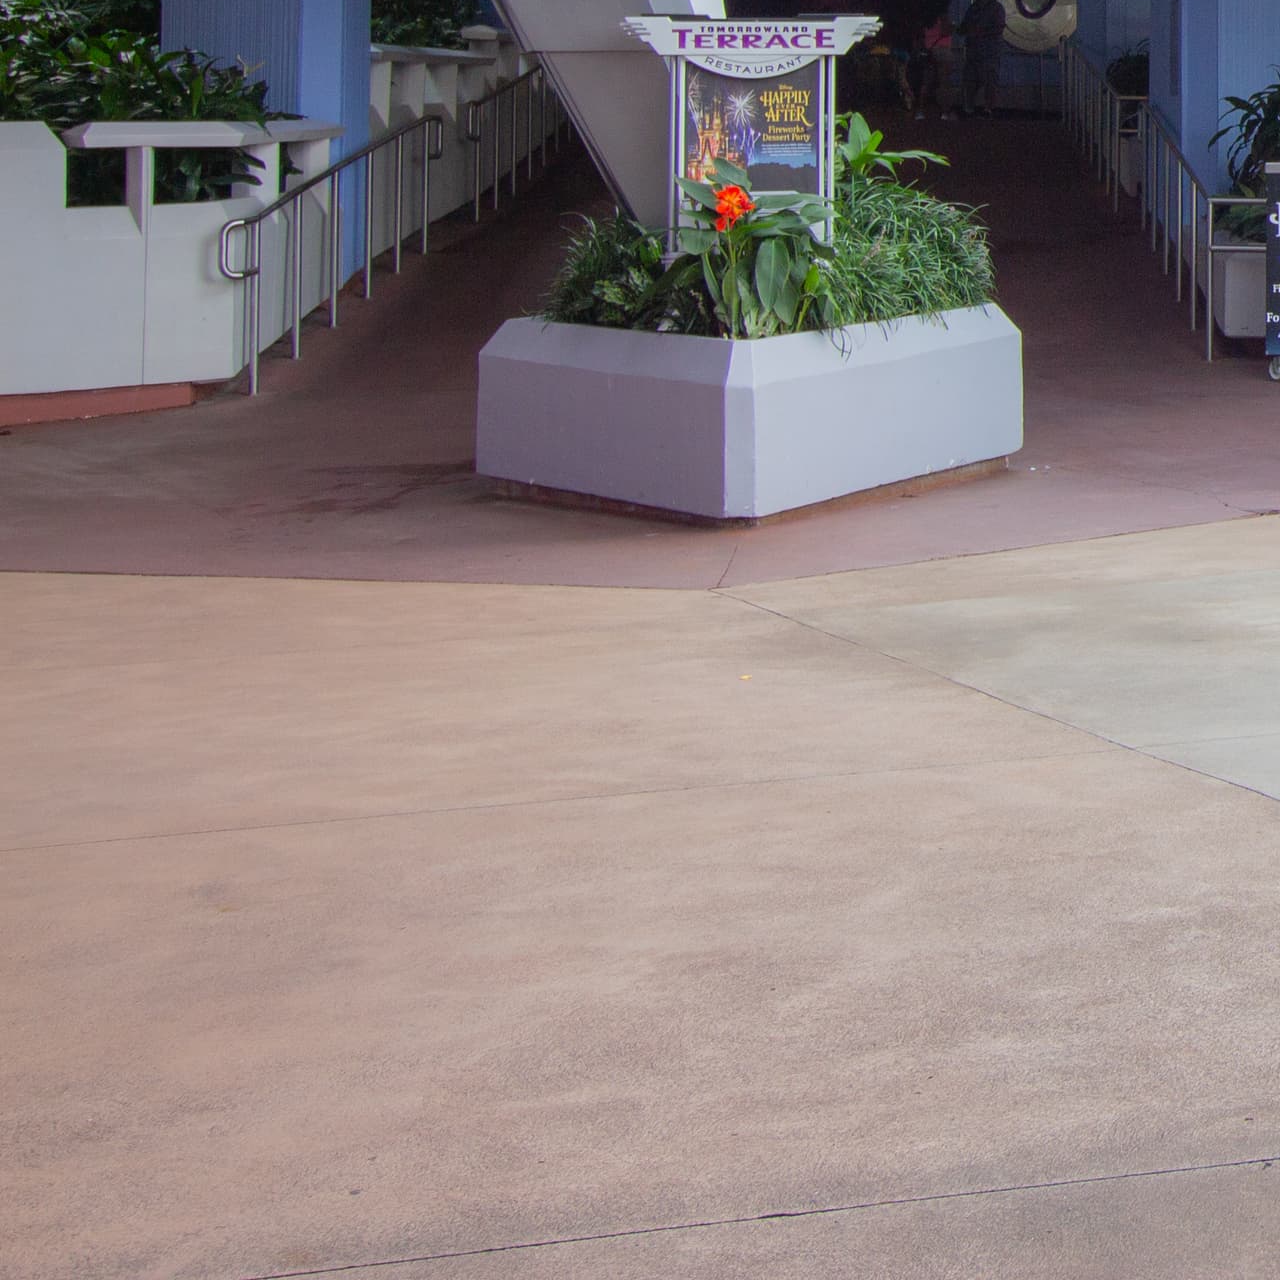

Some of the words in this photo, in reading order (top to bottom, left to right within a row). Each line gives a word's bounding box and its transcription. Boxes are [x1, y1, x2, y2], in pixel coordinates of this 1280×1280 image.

[700, 25, 809, 33] TOMORROWLAND
[671, 28, 836, 49] TERRACE
[704, 56, 802, 75] RESTAURANT
[760, 90, 811, 107] HAPPILY
[765, 105, 815, 127] AFTER
[762, 133, 790, 142] Dessert
[791, 133, 811, 143] Party
[768, 125, 805, 134] Fireworks
